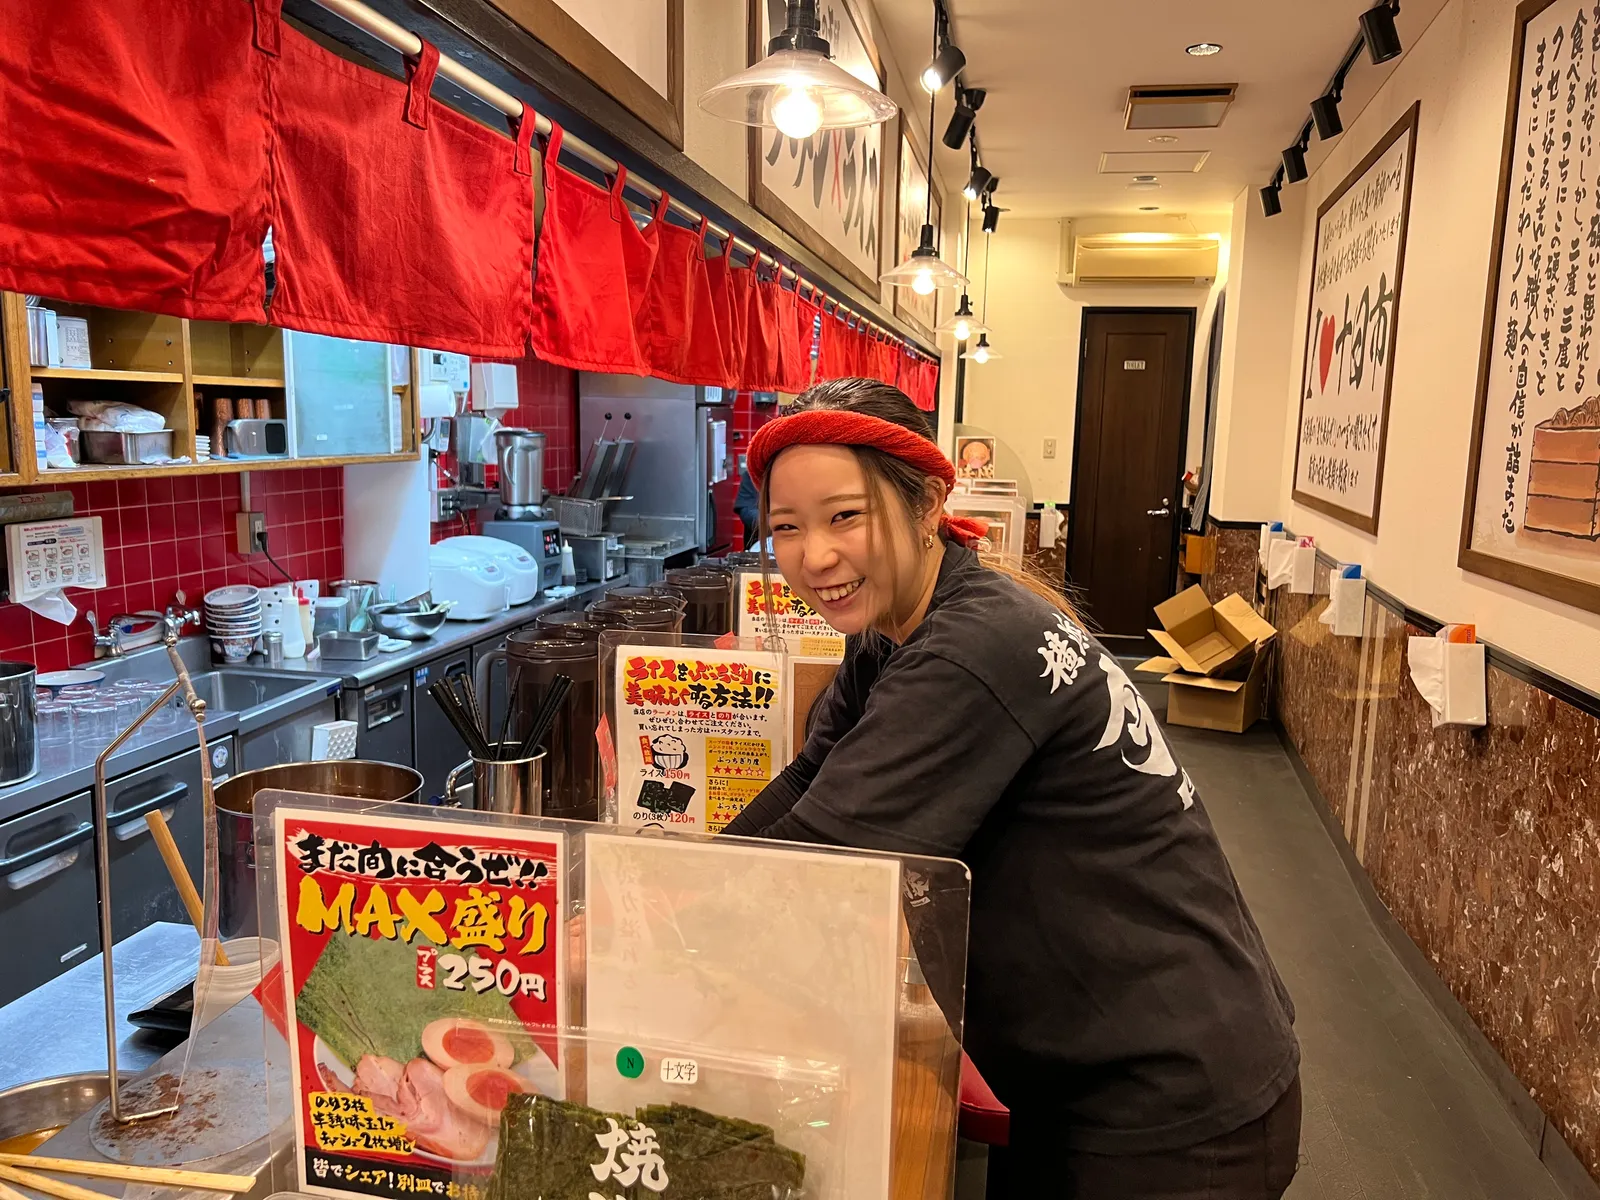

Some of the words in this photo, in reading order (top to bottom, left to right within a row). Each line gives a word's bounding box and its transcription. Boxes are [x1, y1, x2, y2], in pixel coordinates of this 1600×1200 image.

[626, 656, 772, 685] ライスをぶっちぎりに
[296, 833, 549, 889] まだ間に合うぜ!!
[296, 874, 549, 955] MAX盛り
[416, 948, 436, 987] プラス
[438, 953, 548, 1000] 250円
[663, 1061, 697, 1082] 十文字
[589, 1117, 670, 1200] 焼
